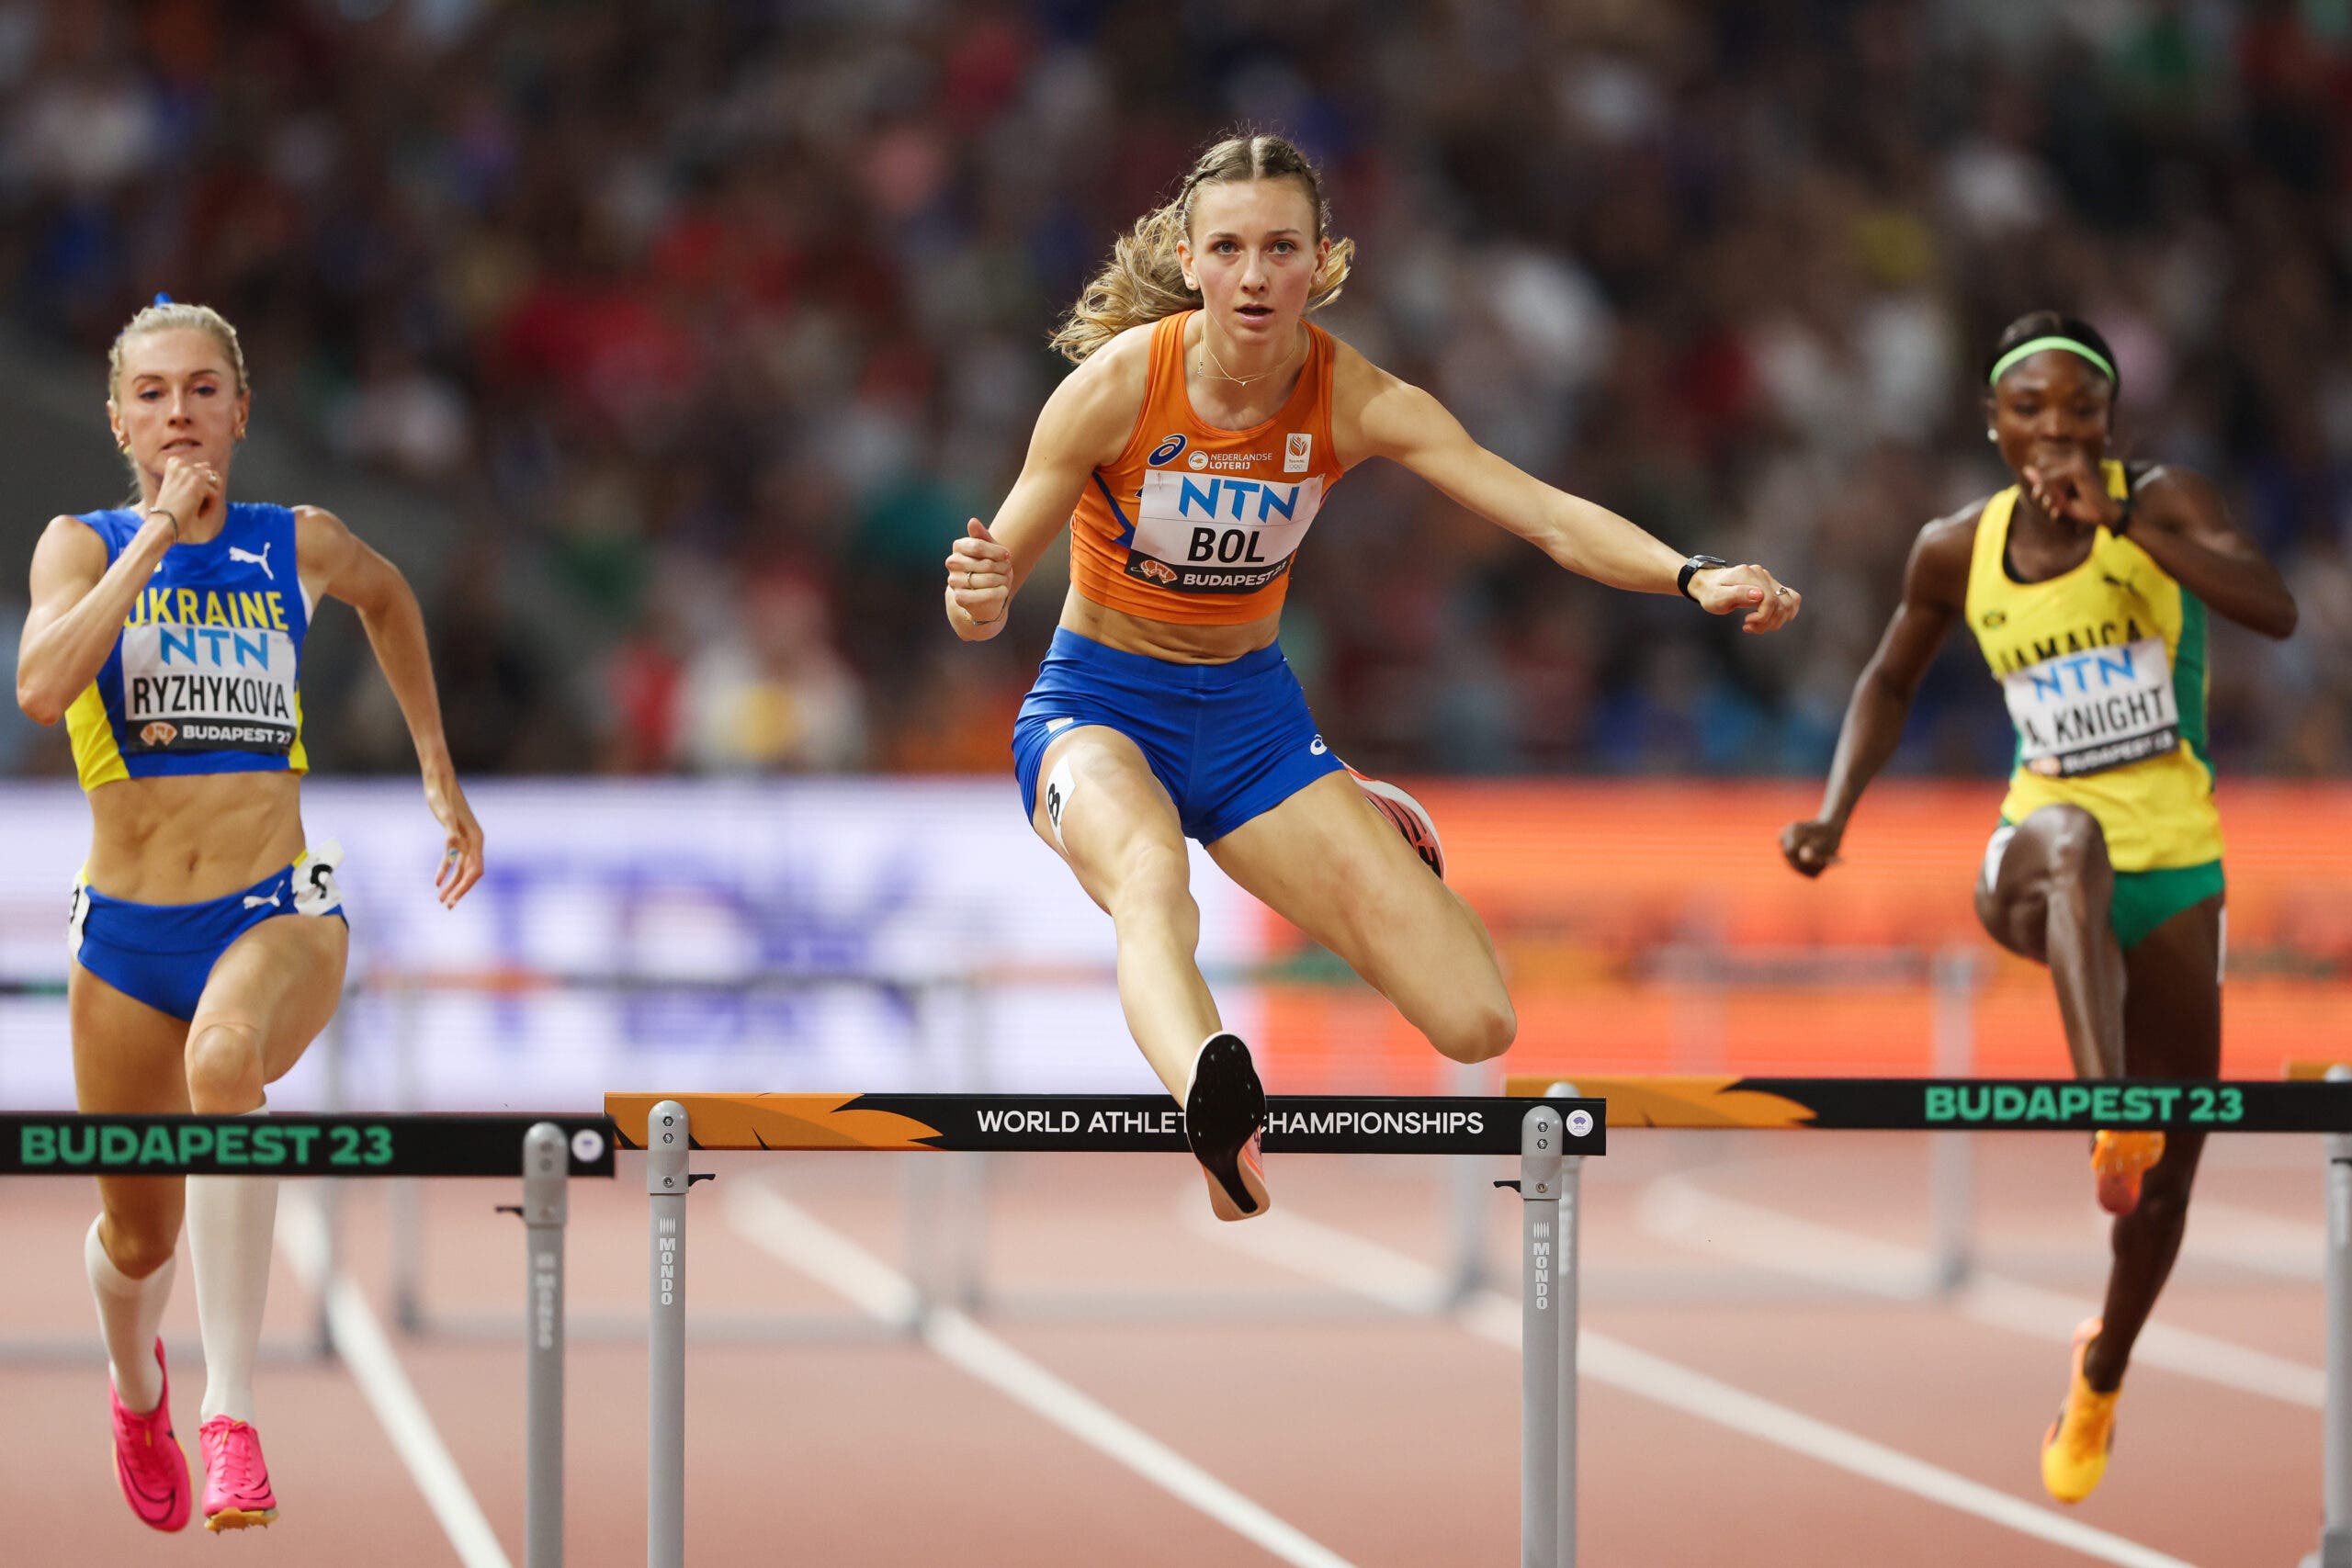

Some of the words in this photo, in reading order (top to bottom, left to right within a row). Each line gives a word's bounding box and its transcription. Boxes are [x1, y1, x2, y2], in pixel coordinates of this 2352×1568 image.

[1209, 461, 1250, 470] LOTERIJ
[1210, 453, 1273, 461] NEDERLANDSE
[1179, 476, 1300, 524] NTN
[1187, 527, 1265, 564] BOL
[1183, 570, 1274, 587] BUDAPEST
[123, 587, 289, 631] UKRAINE
[160, 627, 269, 671] NTN
[2028, 646, 2136, 701] NTN
[133, 676, 289, 719] RYZHYKOVA
[2053, 685, 2166, 742] KNIGHT
[183, 725, 275, 743] BUDAPEST
[1048, 784, 1060, 828] 8
[977, 1111, 1080, 1134] WORLD
[1925, 1087, 2182, 1122] BUDAPEST
[2189, 1088, 2244, 1122] 23
[21, 1125, 321, 1165] BUDAPEST
[330, 1126, 394, 1166] 23
[659, 1237, 676, 1305] MONDO
[1532, 1242, 1550, 1310] MONDO
